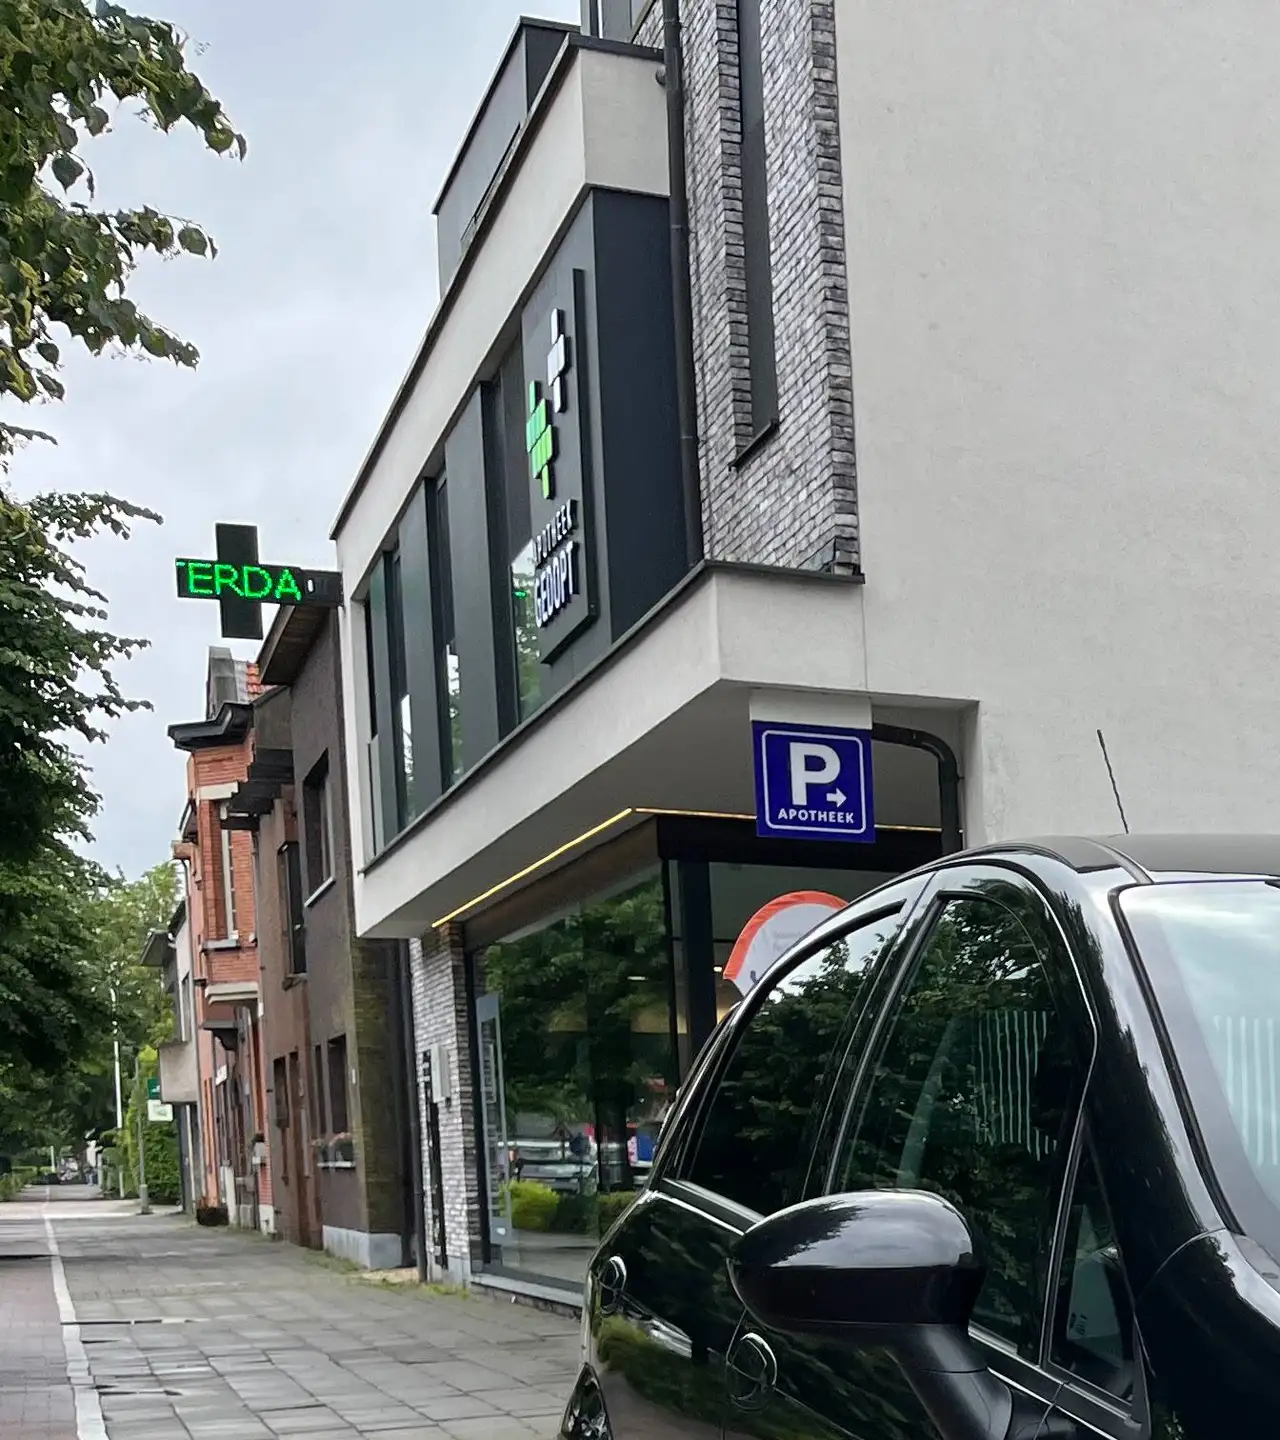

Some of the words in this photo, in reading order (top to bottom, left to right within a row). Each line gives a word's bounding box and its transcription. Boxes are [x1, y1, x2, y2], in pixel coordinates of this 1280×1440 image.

[176, 561, 302, 601] ERDA
[789, 741, 841, 806] P
[777, 808, 855, 824] APOTHEEK
